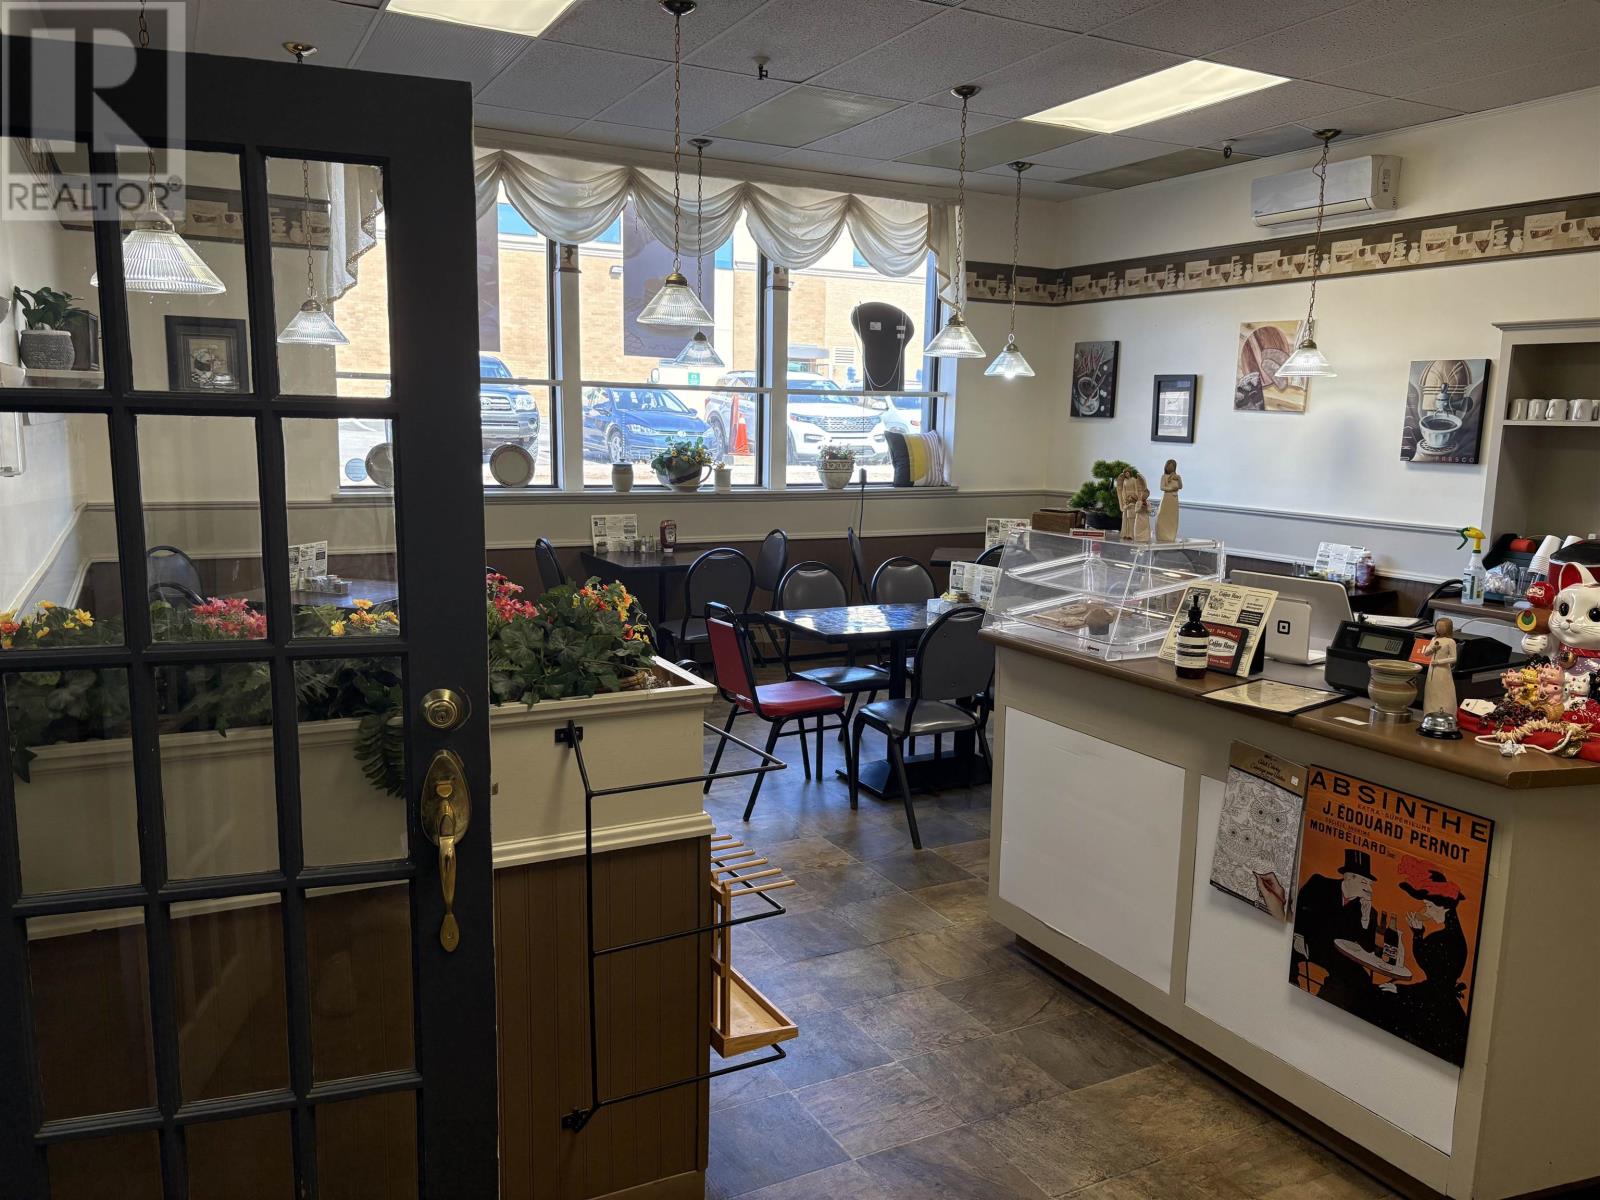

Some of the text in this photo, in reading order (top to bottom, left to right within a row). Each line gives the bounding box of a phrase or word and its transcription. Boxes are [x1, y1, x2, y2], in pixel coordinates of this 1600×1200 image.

[1310, 771, 1488, 842] ABSINTHE
[1322, 801, 1334, 817] J.
[1337, 802, 1404, 840] ÉDOUARD
[1409, 830, 1470, 863] PERNOT
